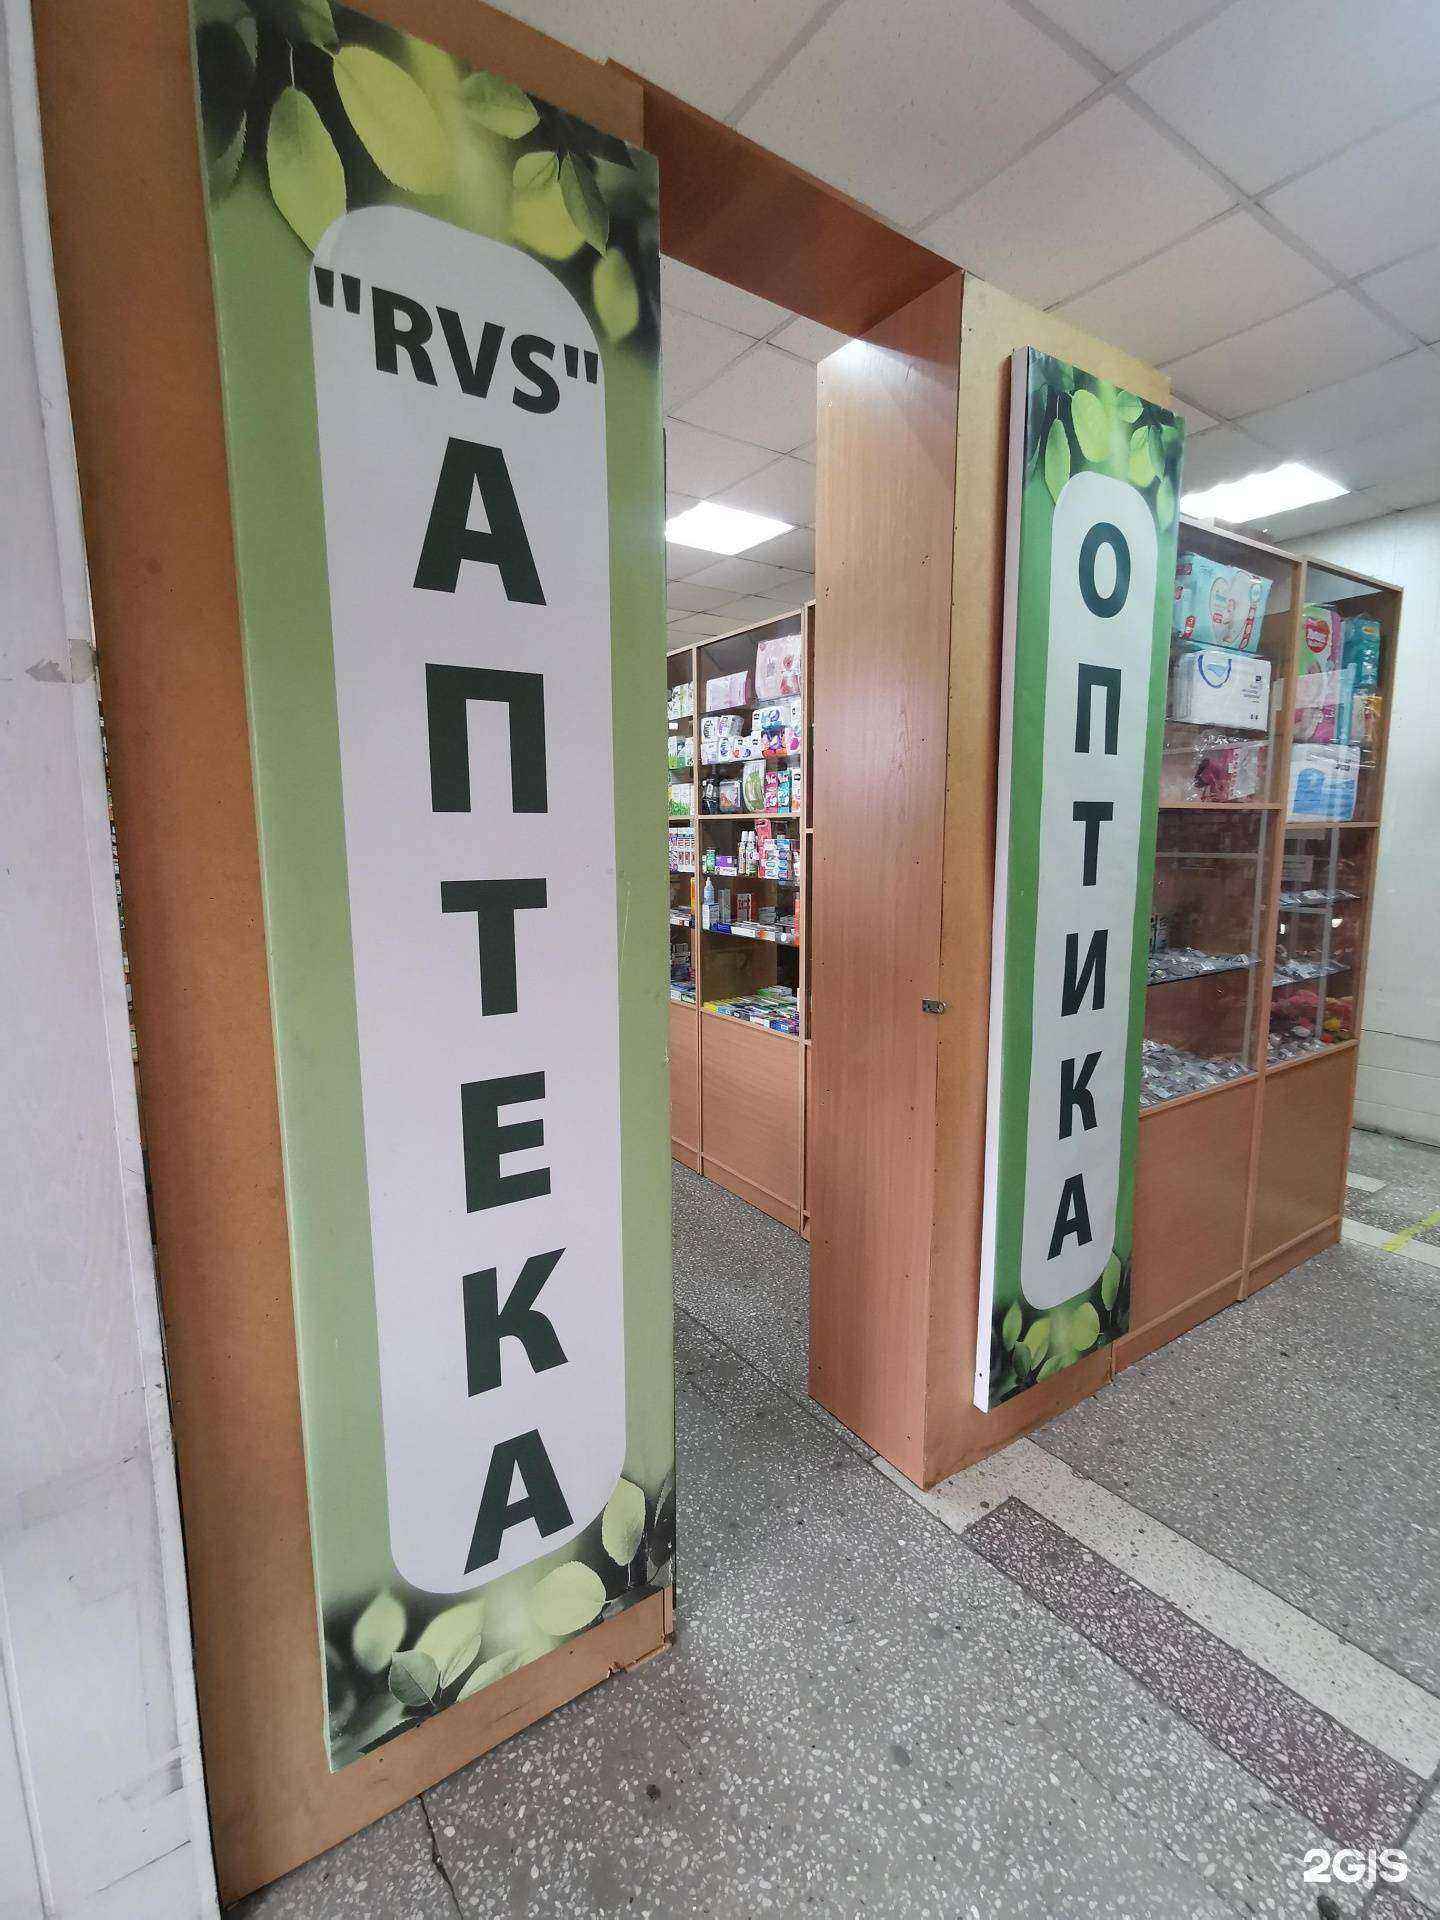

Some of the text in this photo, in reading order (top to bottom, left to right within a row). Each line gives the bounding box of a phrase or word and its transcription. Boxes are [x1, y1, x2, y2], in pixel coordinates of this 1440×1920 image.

[313, 265, 599, 415] "RVS"
[412, 436, 574, 1576] АПТЕКА
[1046, 521, 1131, 1261] ОПТИКА
